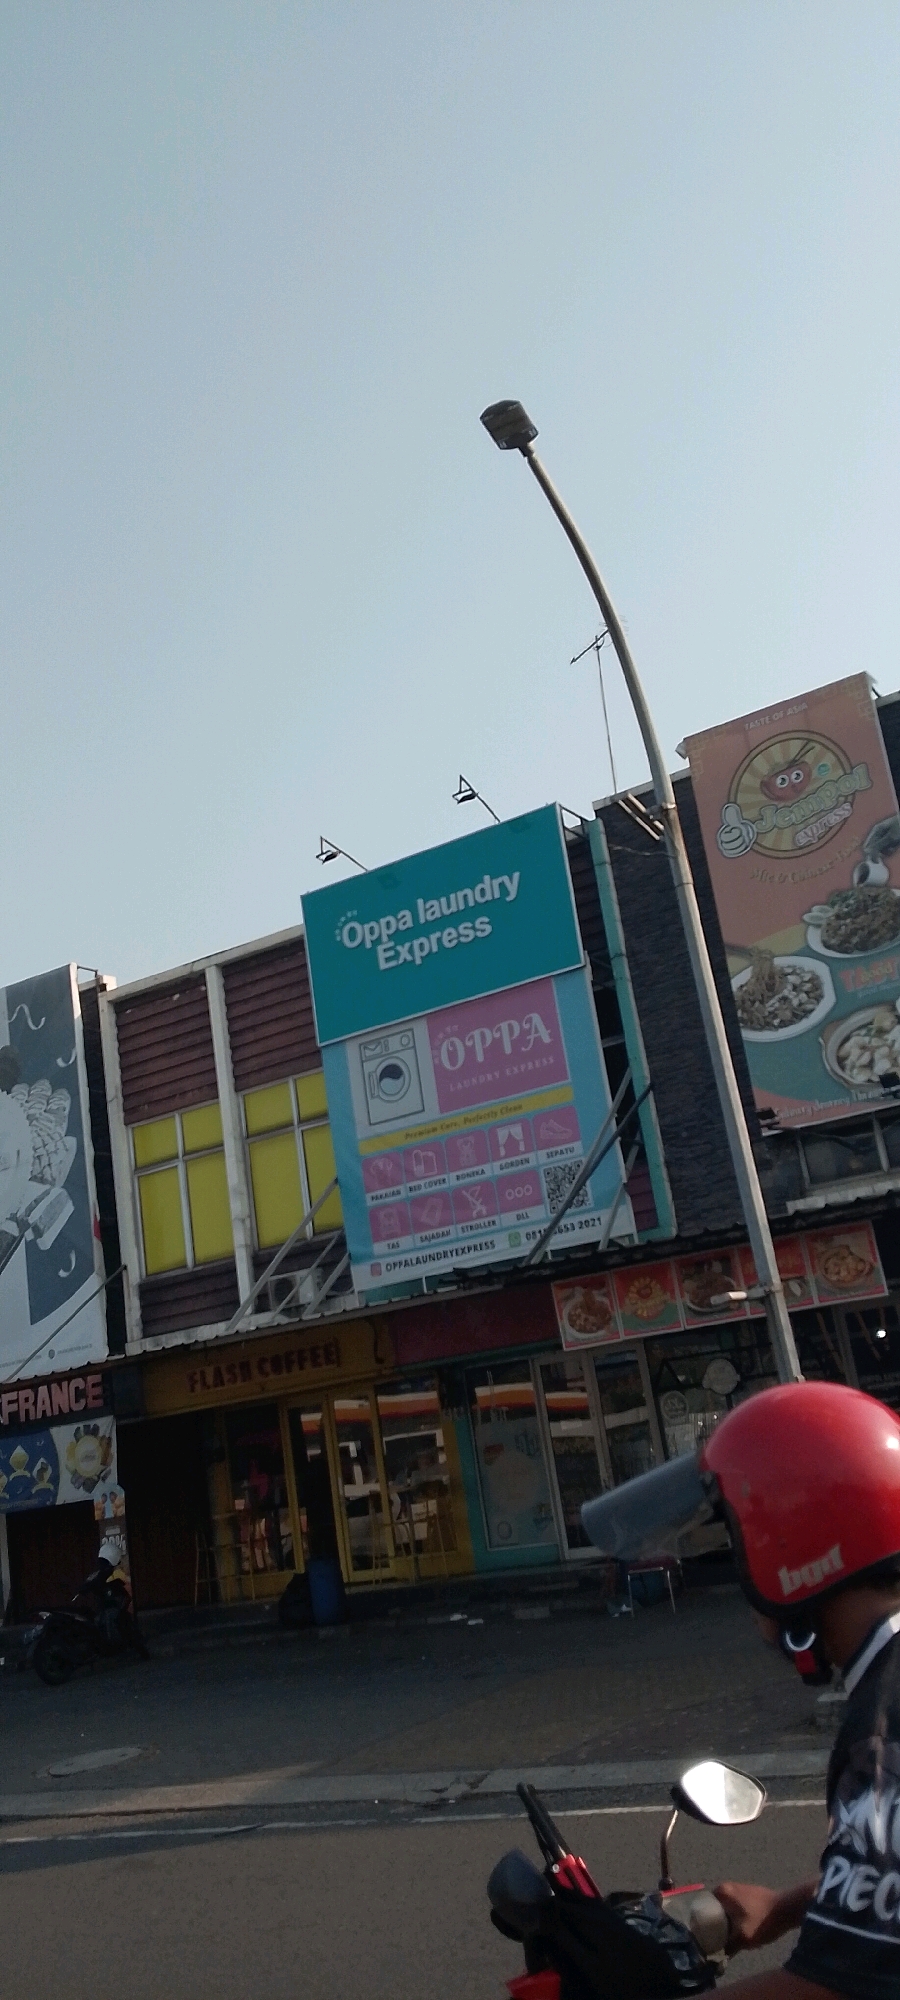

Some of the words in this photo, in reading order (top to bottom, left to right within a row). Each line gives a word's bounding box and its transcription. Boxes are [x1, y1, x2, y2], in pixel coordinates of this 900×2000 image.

[744, 715, 771, 731] TASTE
[772, 710, 784, 721] OF
[786, 702, 808, 716] ASIA
[342, 909, 414, 949] Oppa
[416, 871, 520, 925] laundry
[377, 915, 493, 971] Express
[441, 1012, 553, 1071] OPPA
[449, 1070, 500, 1092] LAUNDRY
[505, 1055, 554, 1077] EXPRESS
[404, 1125, 438, 1140] Premium
[463, 1110, 498, 1126] Perfectly
[499, 1103, 523, 1116] Clean
[546, 1146, 575, 1159] SEPATU
[499, 1157, 530, 1171] GORDEN
[456, 1168, 486, 1181] BONEKA
[408, 1184, 423, 1193] BED
[424, 1177, 446, 1190] COVER
[371, 1189, 402, 1202] PAKAIAN
[516, 1211, 530, 1221] DLL
[577, 1216, 602, 1230] 2021
[460, 1219, 497, 1233] STROLLER
[420, 1229, 451, 1243] SAJADAH
[387, 1241, 400, 1250] TAS
[385, 1239, 496, 1272] OPPALAUNDRYEXPRESS
[186, 1360, 252, 1393] FLASH
[257, 1341, 336, 1378] COFFEE
